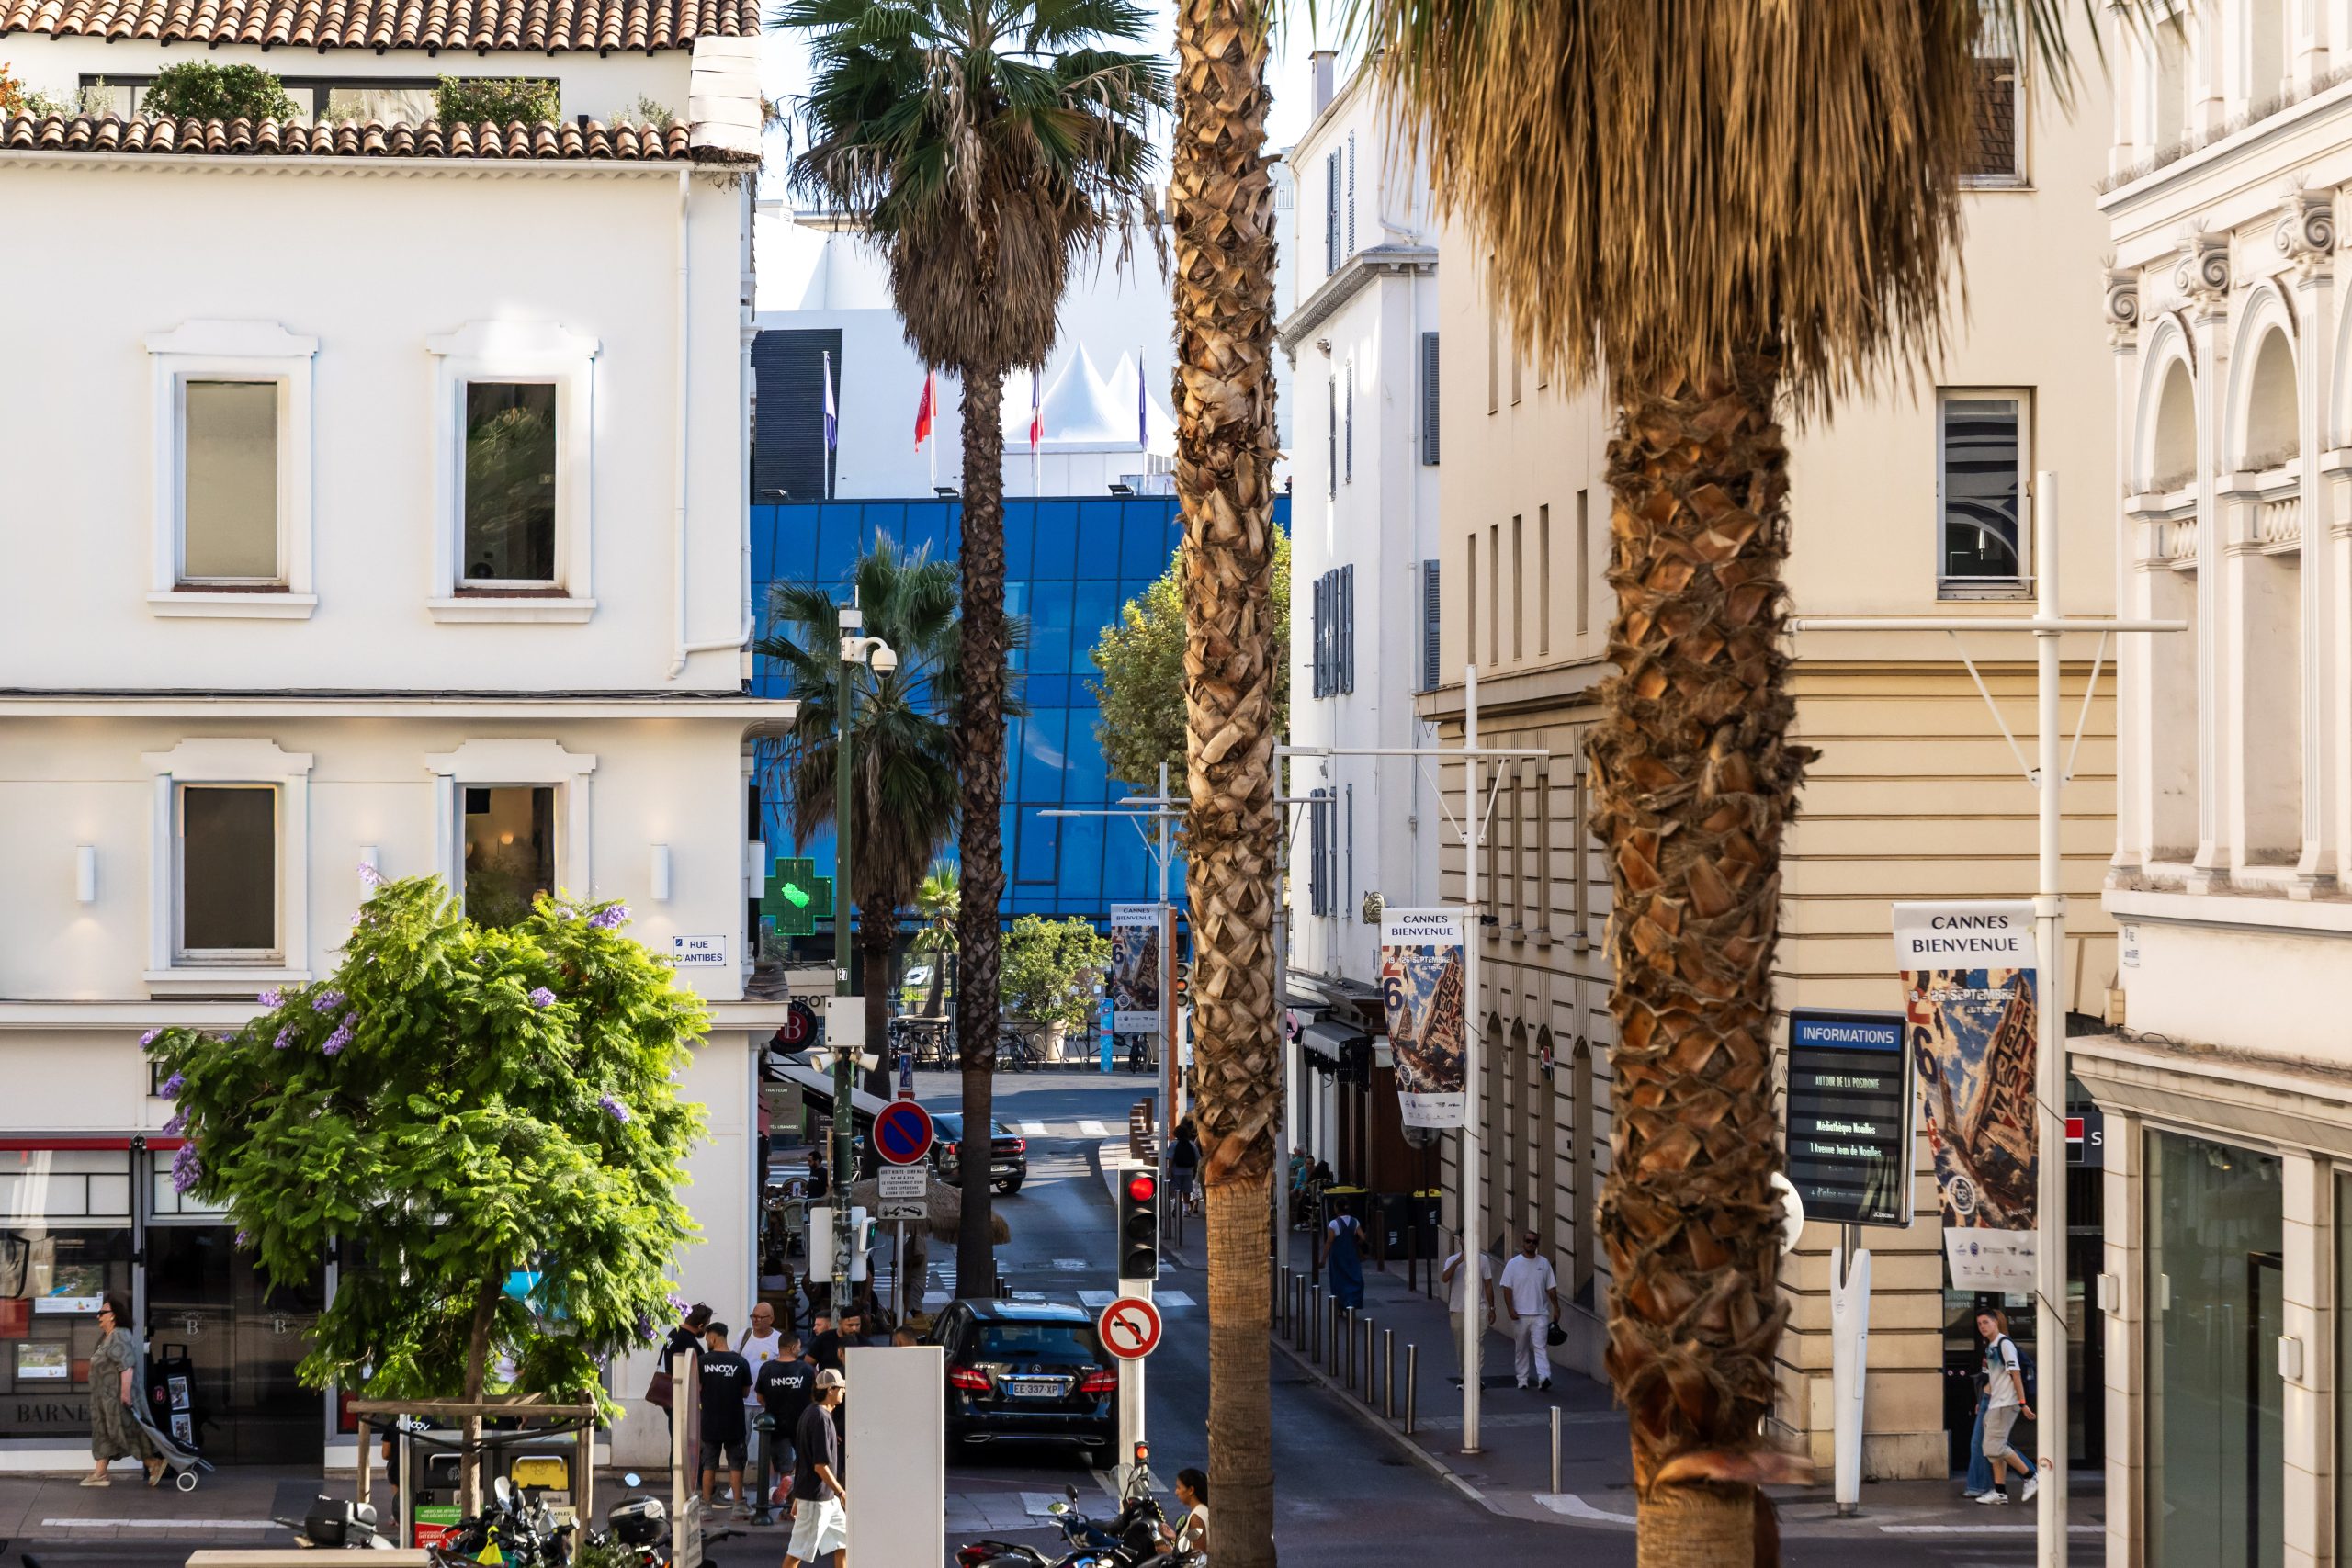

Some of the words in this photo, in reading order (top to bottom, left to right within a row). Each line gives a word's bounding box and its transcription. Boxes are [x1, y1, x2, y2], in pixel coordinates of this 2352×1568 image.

[1403, 915, 1448, 923] CANNES
[1931, 915, 2008, 930] CANNES
[1391, 927, 1453, 936] BIENVENUE
[690, 941, 708, 949] RUE
[1912, 937, 2019, 953] BIENVENUE
[676, 953, 723, 963] D'ANTIBES
[1412, 955, 1451, 964] SEPTEMBRE
[837, 968, 848, 981] 87
[1950, 987, 2017, 1002] SEPTEMBRE
[784, 1014, 802, 1040] B
[1803, 1026, 1894, 1044] INFORMATIONS
[1815, 1075, 1836, 1087] AUTOUR
[1837, 1077, 1843, 1088] DE
[1844, 1077, 1851, 1088] LA
[1852, 1077, 1880, 1089] POSIDONIE
[1816, 1120, 1853, 1135] Médiathèque
[1853, 1122, 1876, 1134] Noailles
[1815, 1143, 1835, 1155] Avenue
[1837, 1144, 1849, 1156] Jean
[1850, 1144, 1858, 1156] de
[1859, 1145, 1882, 1157] Noailles
[187, 1319, 199, 1336] B
[275, 1318, 287, 1335] B
[704, 1364, 738, 1373] INNOOV
[771, 1375, 804, 1387] INNOOV
[1014, 1382, 1058, 1395] EE-337-XP
